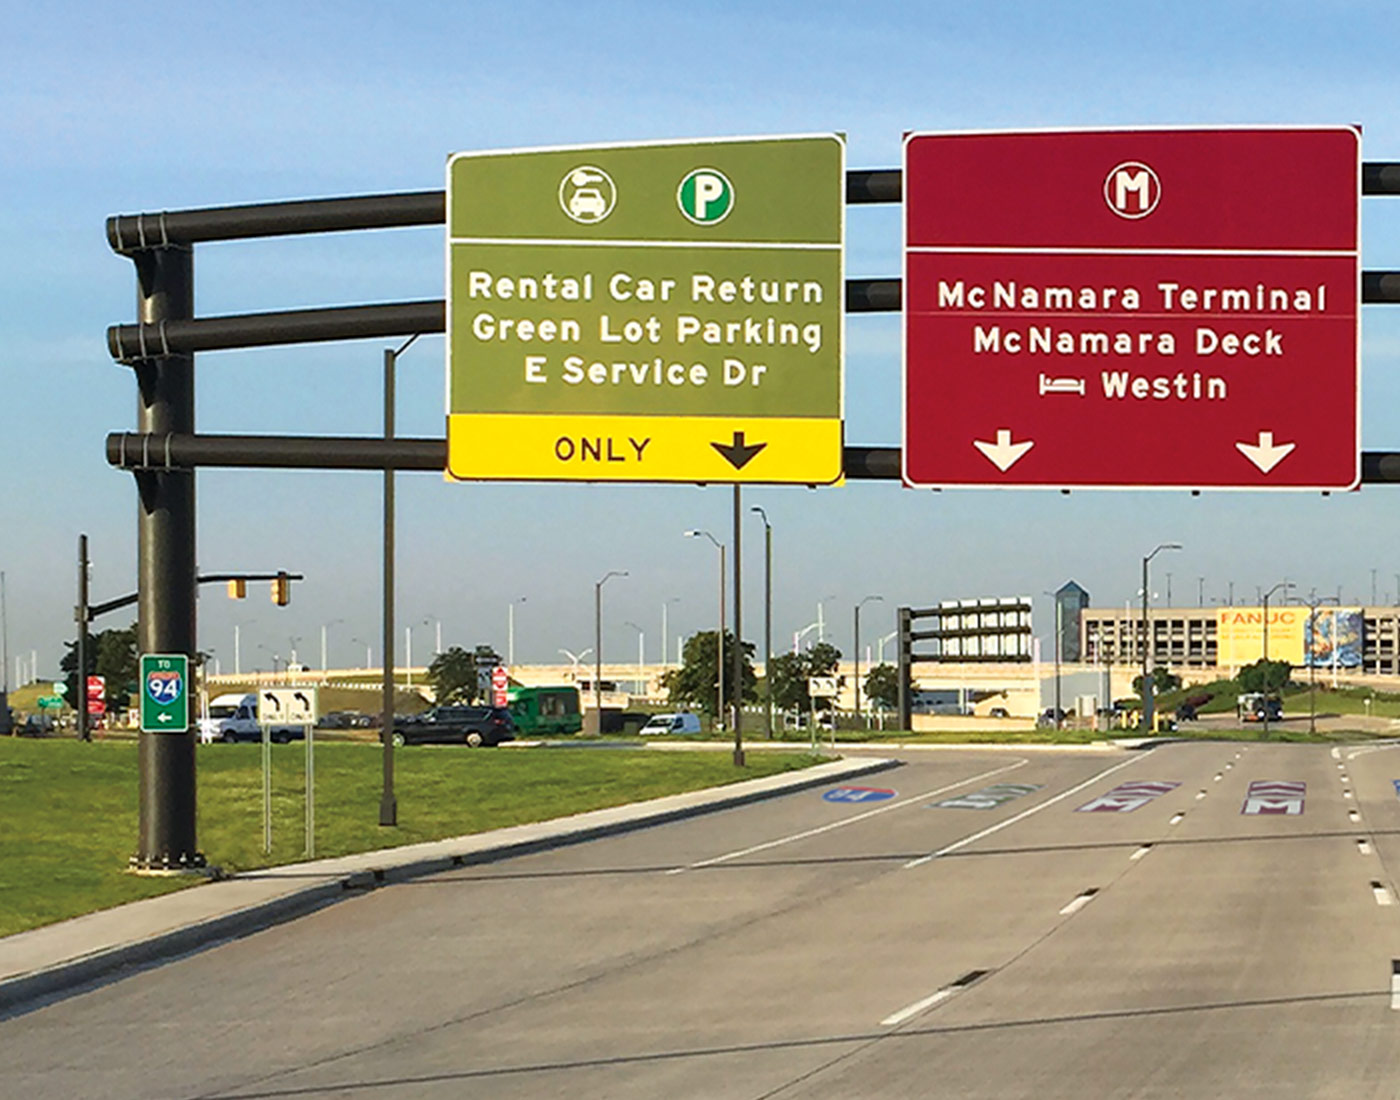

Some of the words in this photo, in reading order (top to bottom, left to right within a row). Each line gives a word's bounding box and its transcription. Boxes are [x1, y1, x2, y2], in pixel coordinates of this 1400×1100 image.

[694, 174, 724, 219] P
[1115, 170, 1150, 210] M
[469, 271, 592, 300] Rental
[609, 273, 676, 301] Car
[692, 275, 823, 303] Return
[938, 281, 1140, 310] McNamara
[1157, 283, 1326, 311] Terminal
[473, 313, 580, 342] Green
[600, 315, 661, 343] Lot
[677, 316, 822, 353] Parking
[974, 326, 1175, 354] McNamara
[1196, 328, 1284, 355] Deck
[525, 356, 547, 383] E
[562, 356, 708, 385] Service
[724, 359, 767, 386] Dr
[1101, 371, 1228, 399] Westin
[554, 436, 651, 462] ONLY
[1221, 612, 1296, 625] FANUC
[157, 660, 171, 669] TO
[150, 679, 178, 698] 94
[1245, 799, 1302, 815] M
